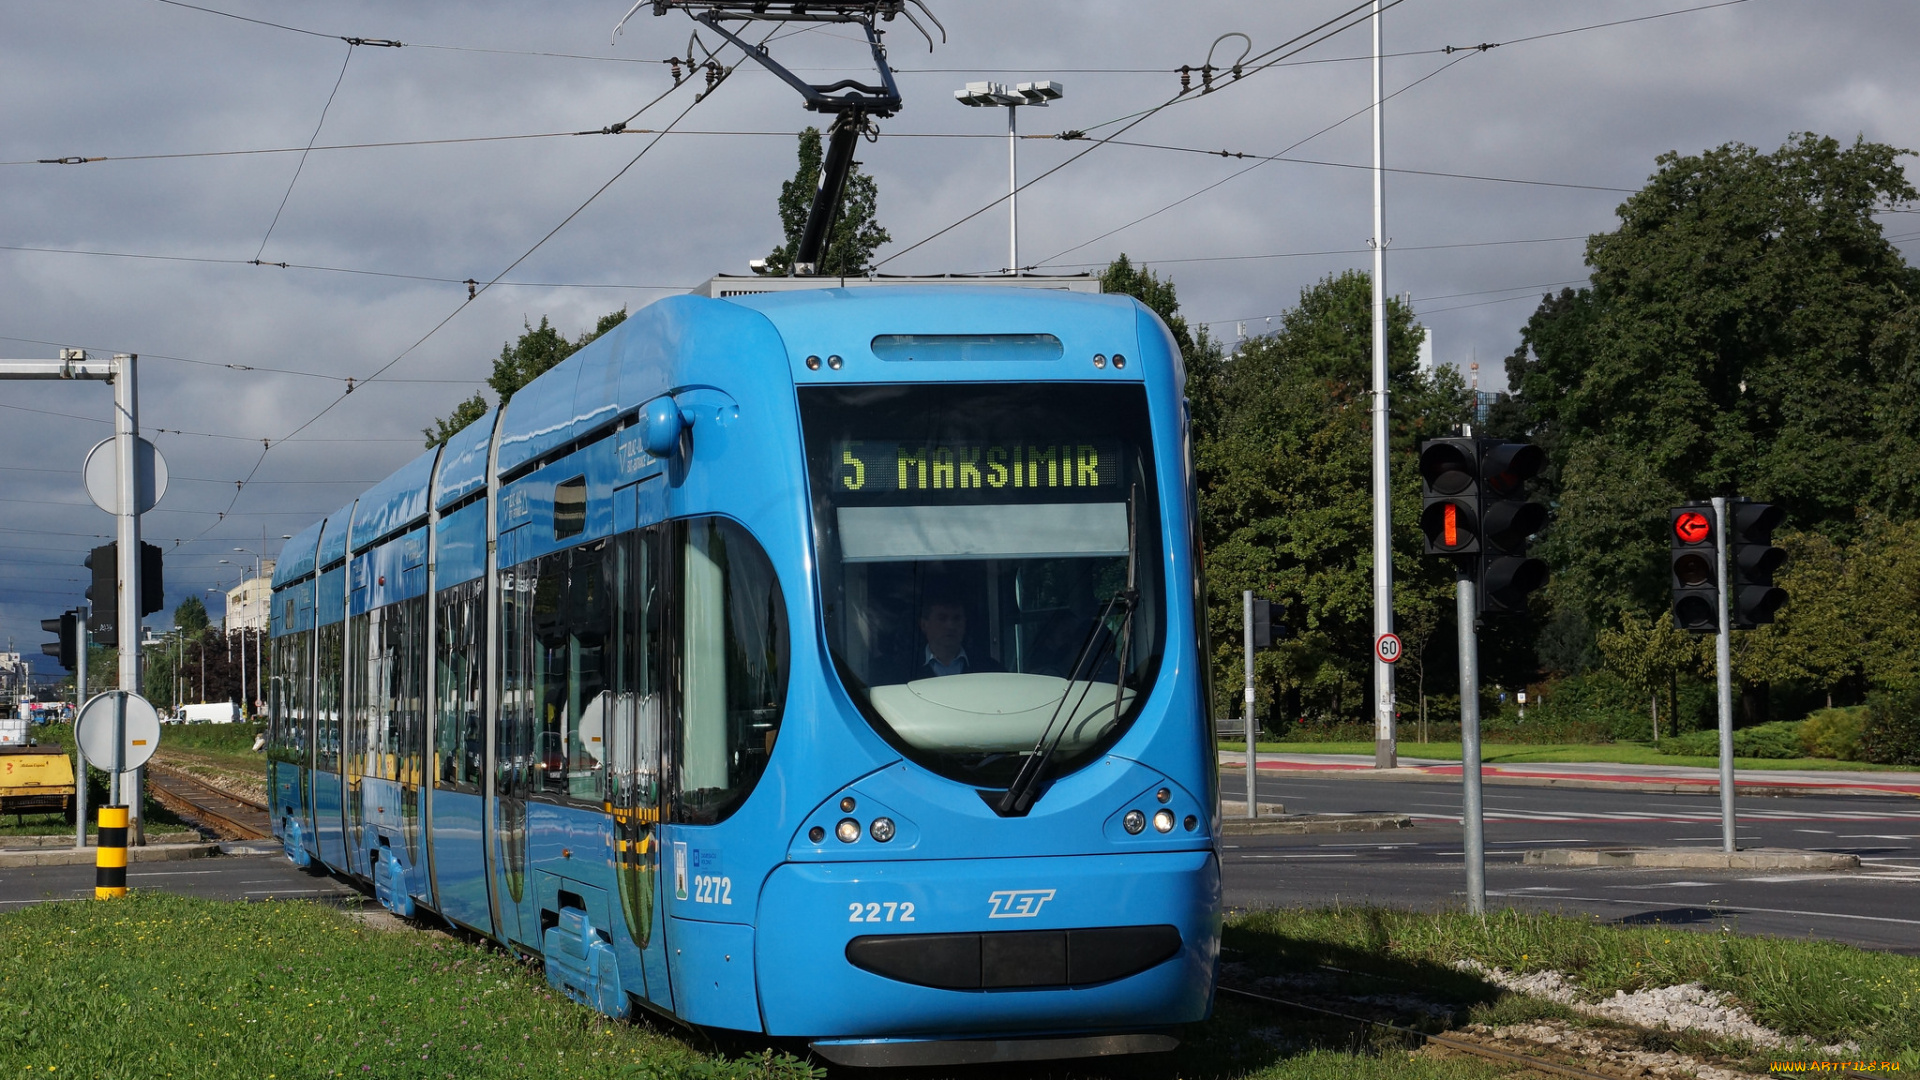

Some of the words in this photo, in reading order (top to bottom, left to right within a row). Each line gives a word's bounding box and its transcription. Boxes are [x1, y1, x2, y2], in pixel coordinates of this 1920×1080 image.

[843, 441, 865, 490] 5
[897, 445, 1099, 489] MAKSIMIR
[1382, 641, 1396, 655] 60
[694, 875, 732, 905] 2272
[988, 889, 1057, 919] ZET
[848, 902, 916, 923] 2272
